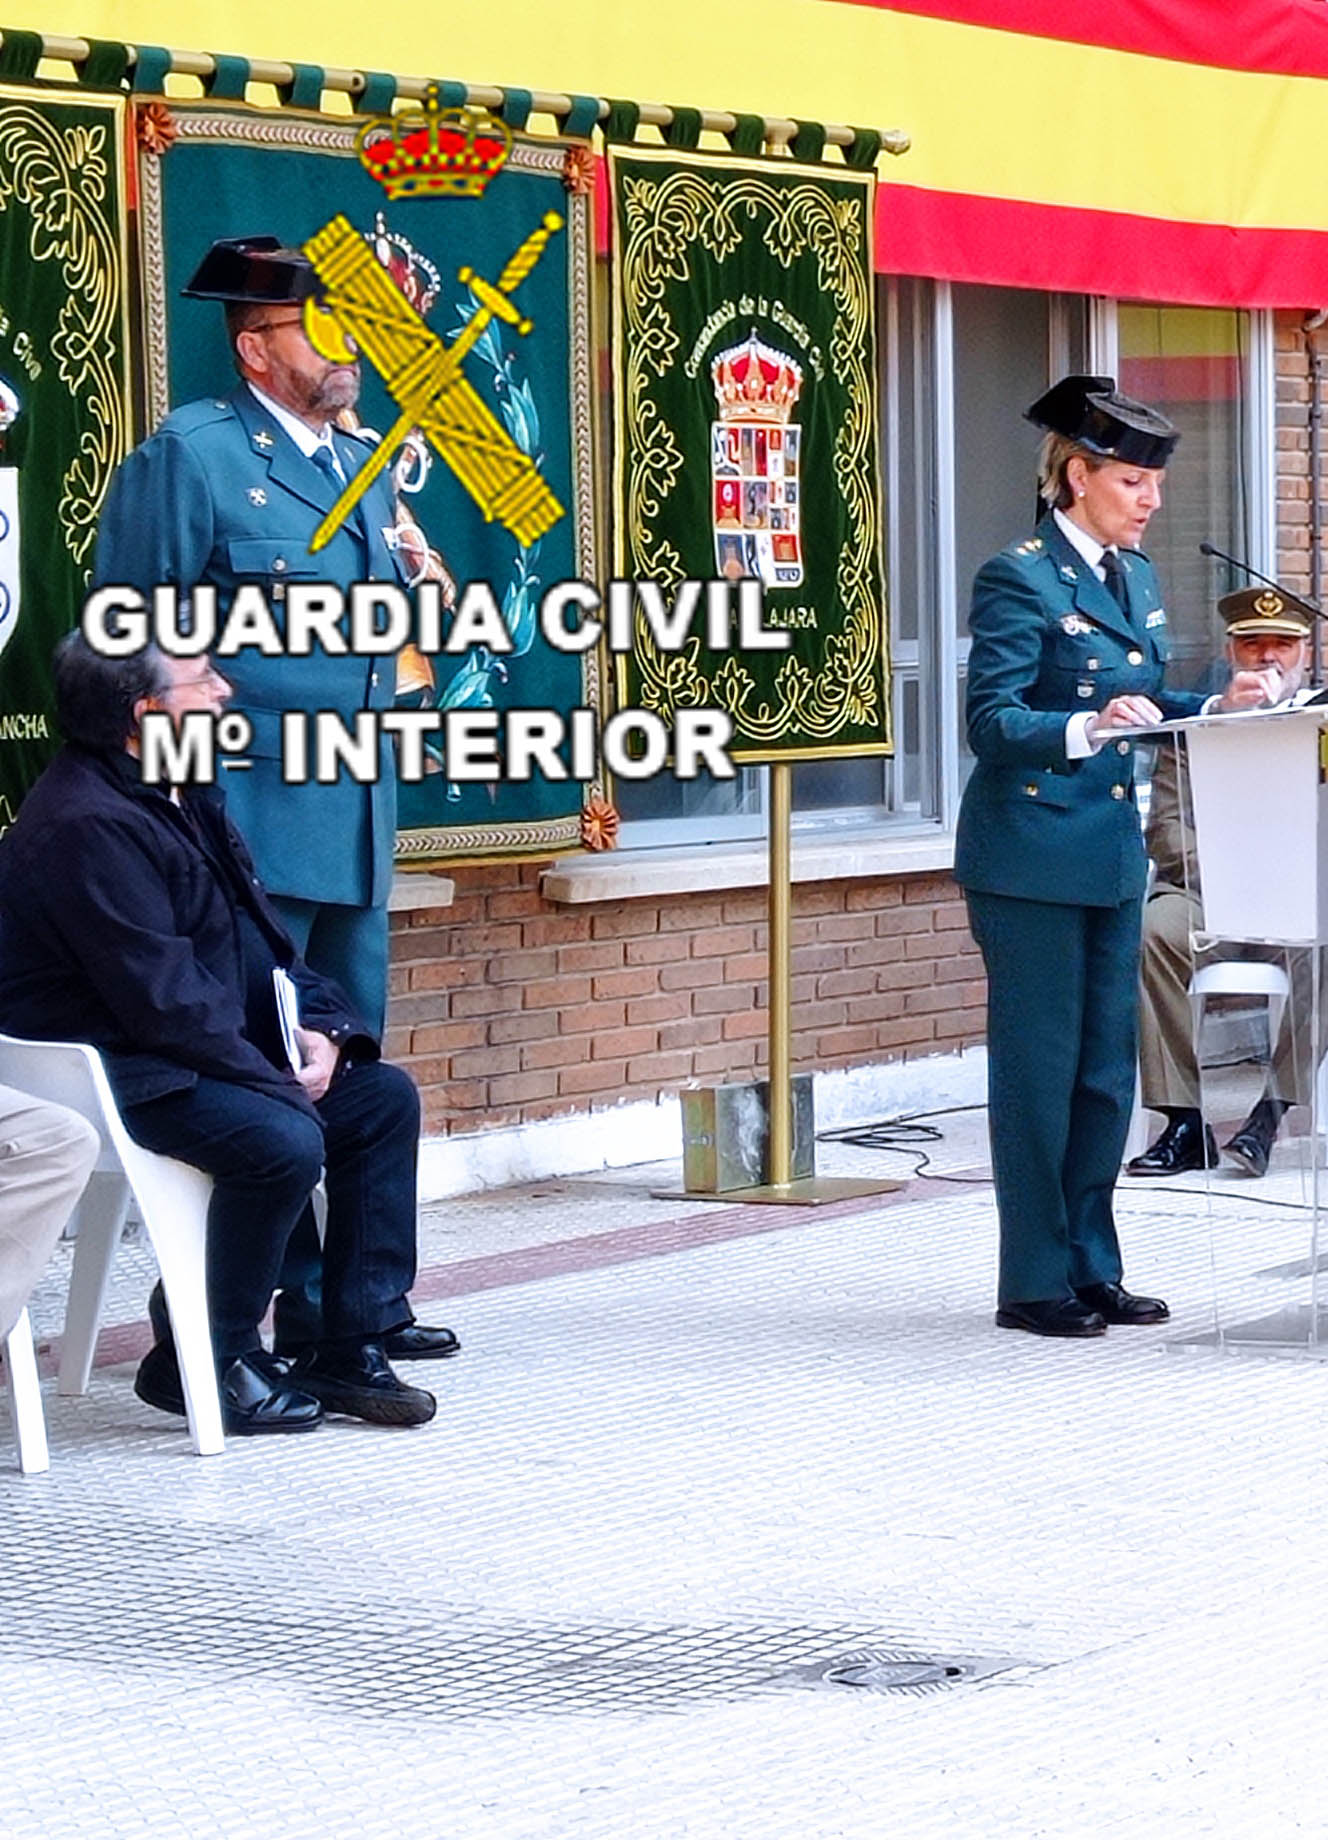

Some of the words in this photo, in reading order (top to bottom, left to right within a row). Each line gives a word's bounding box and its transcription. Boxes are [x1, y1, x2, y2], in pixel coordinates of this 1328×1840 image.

[738, 293, 755, 316] de
[758, 294, 768, 317] la
[772, 300, 811, 350] Guardia
[0, 713, 49, 740] NCHA
